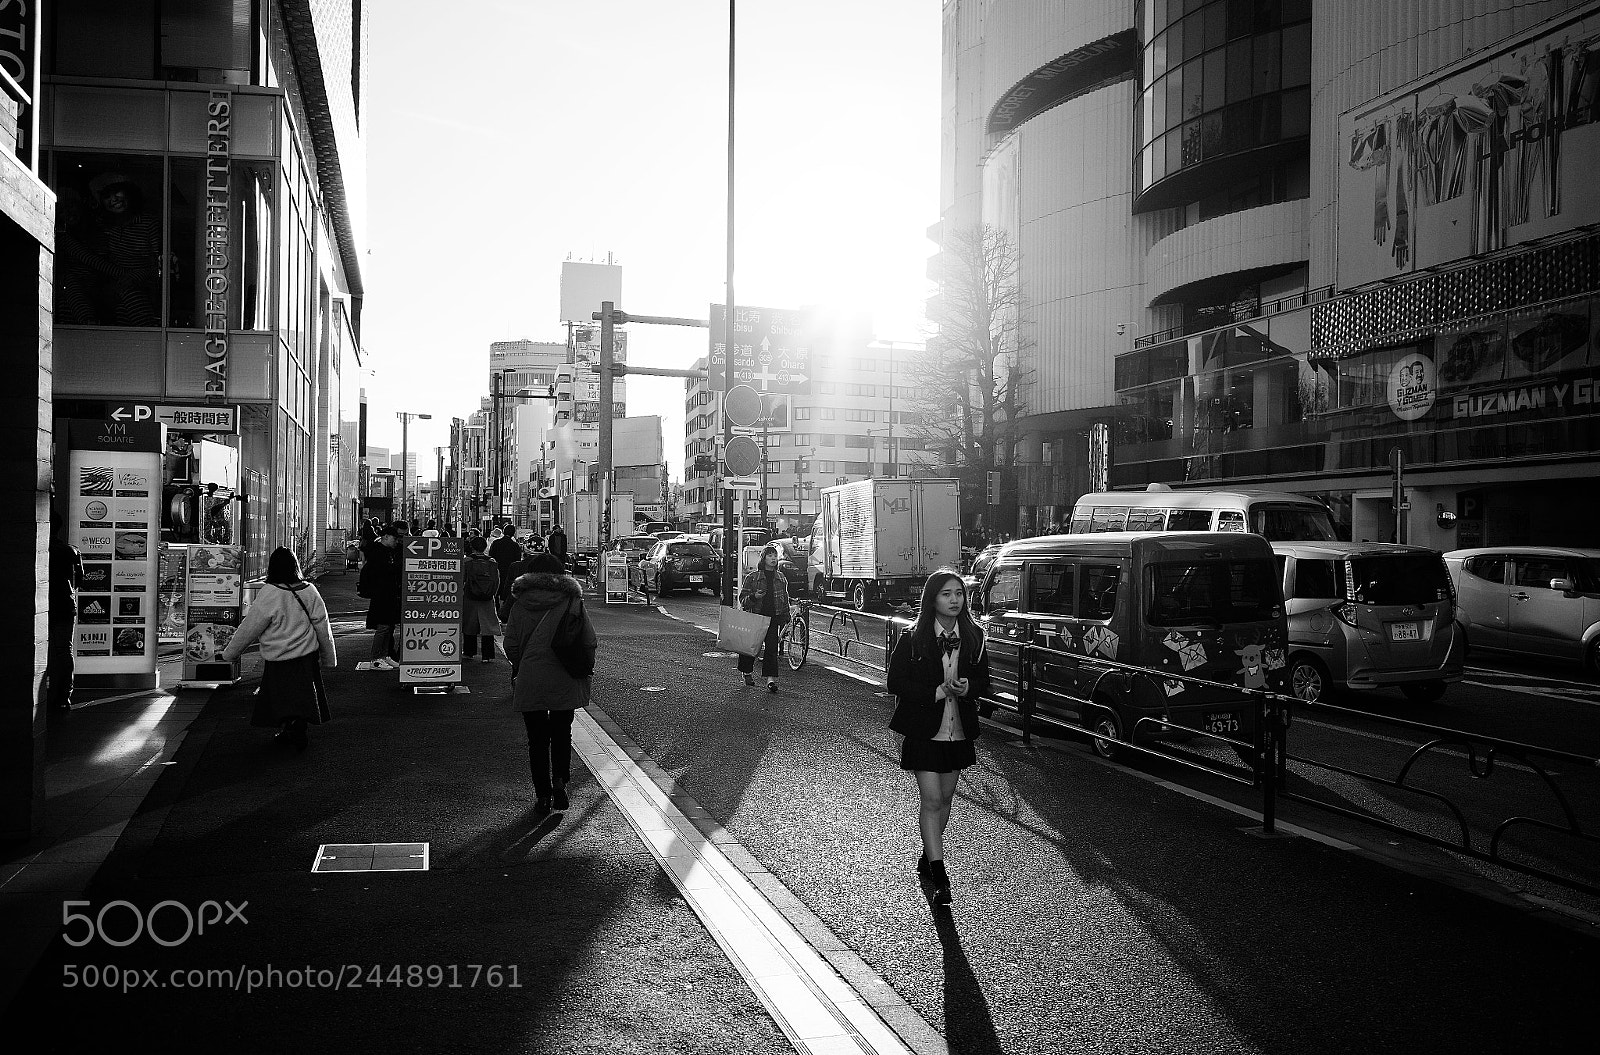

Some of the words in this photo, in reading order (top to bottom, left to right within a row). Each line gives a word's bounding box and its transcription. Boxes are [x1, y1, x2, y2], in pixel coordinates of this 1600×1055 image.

[991, 84, 1037, 126] LAFORET
[1034, 39, 1122, 81] MUSEUM
[205, 102, 229, 295] OUTFITTERS
[722, 308, 760, 324] 比寿
[204, 299, 227, 397] EAGLE
[711, 355, 755, 368] Omsando
[780, 359, 805, 370] Ohara
[1396, 383, 1428, 398] GUZMAN
[1452, 387, 1546, 420] GUZMAN
[1552, 383, 1570, 408] Y
[134, 405, 152, 422] P
[159, 410, 230, 426] 一般時間貸
[104, 423, 126, 435] YM
[97, 435, 135, 444] SQUARE
[88, 537, 111, 545] WEGO
[427, 538, 442, 557] P
[408, 560, 457, 571] 一般時間貸
[407, 581, 458, 593] ¥2000
[425, 594, 457, 603] ¥2400
[80, 633, 107, 642] KINJI
[405, 628, 458, 638] ハイルーフ
[405, 639, 430, 651] OK
[410, 667, 432, 675] TRUST
[1211, 719, 1239, 733] 69-73
